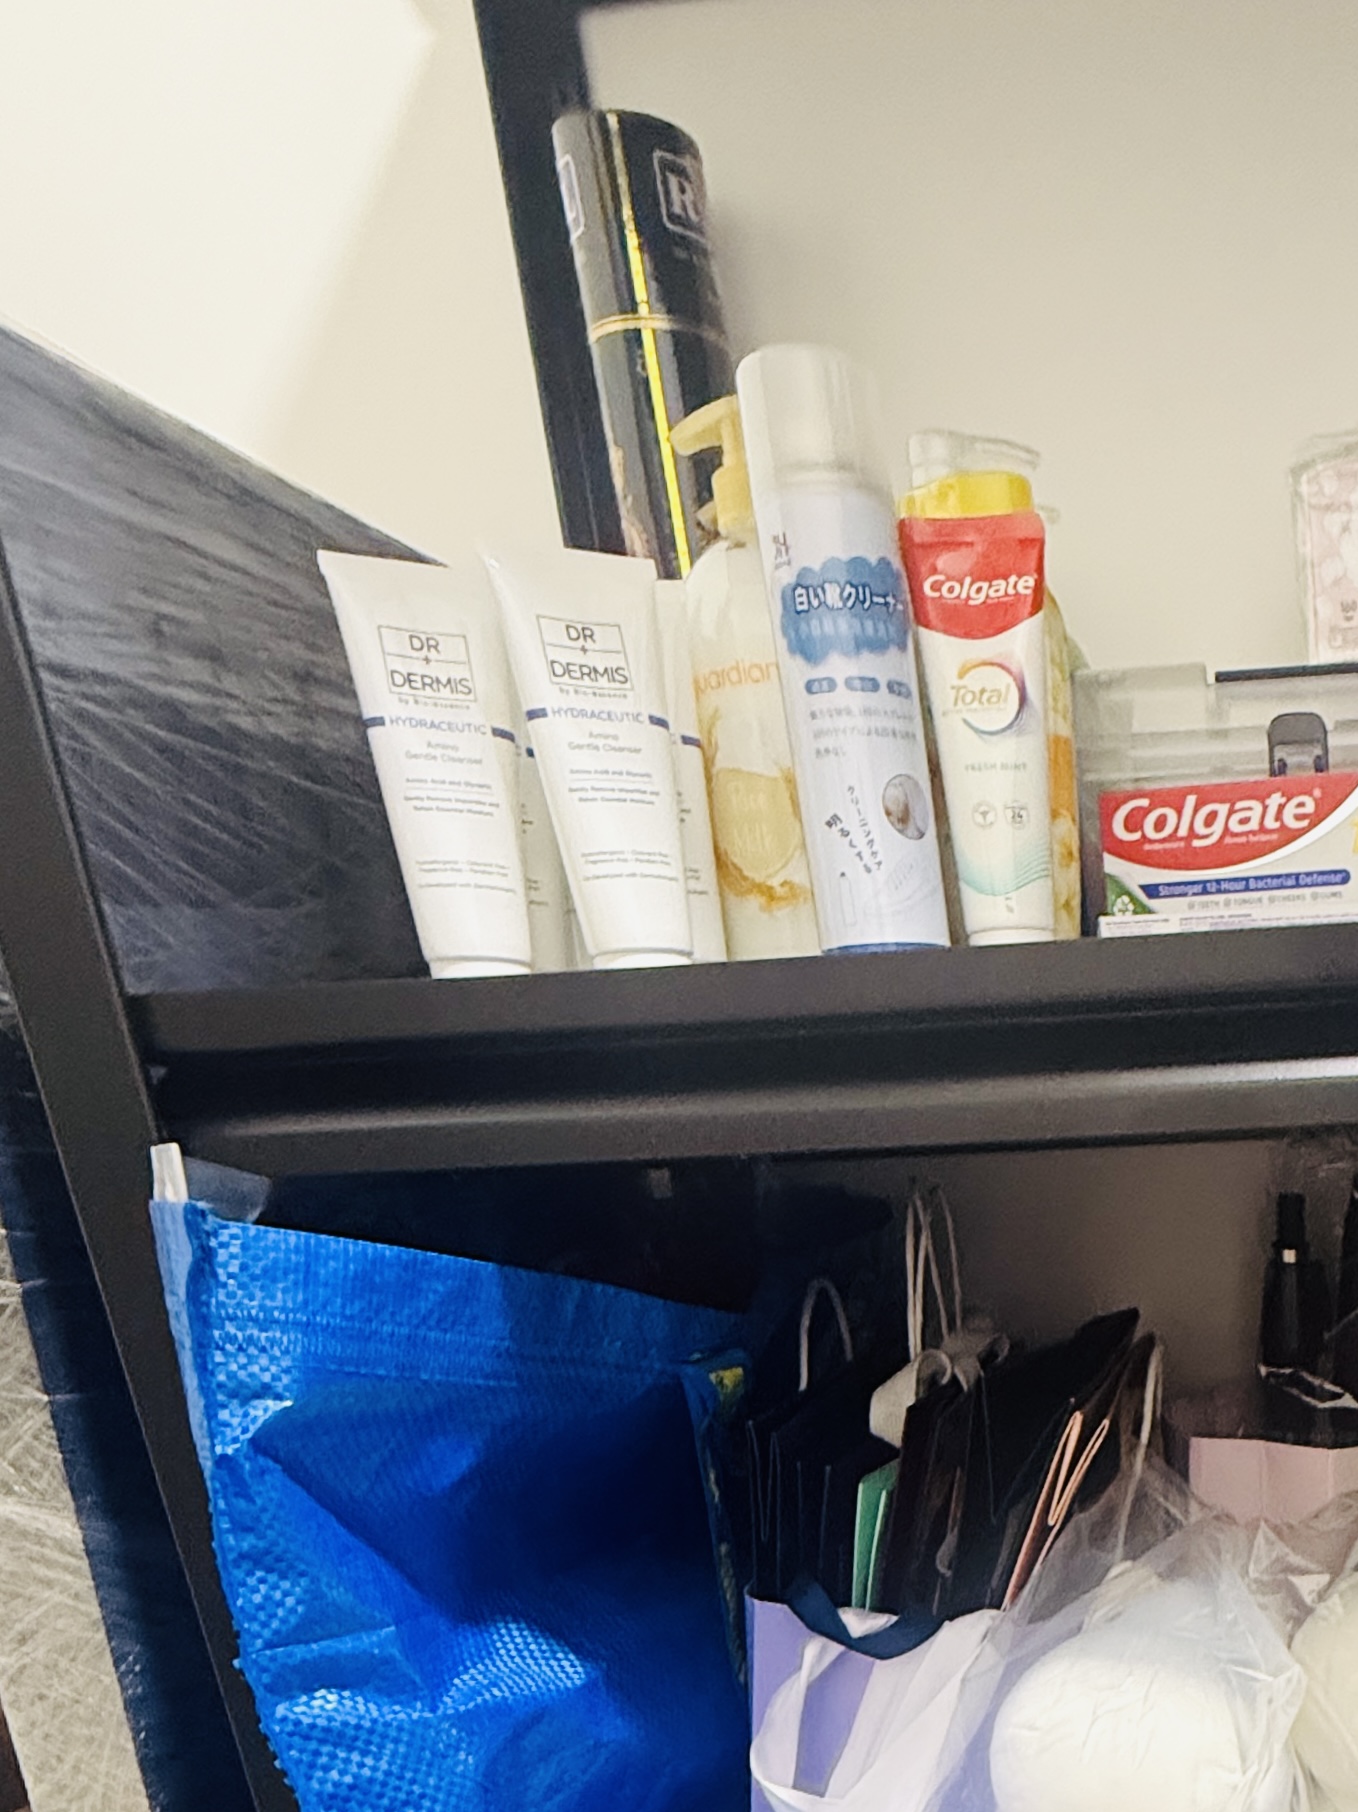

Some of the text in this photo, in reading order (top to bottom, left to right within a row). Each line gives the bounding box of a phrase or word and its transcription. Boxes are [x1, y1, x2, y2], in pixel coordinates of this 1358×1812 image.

[923, 573, 1036, 605] Colgate
[408, 634, 442, 654] DR
[565, 624, 597, 644] DR
[390, 670, 473, 696] DERMIS
[550, 660, 629, 685] DERMIS
[950, 682, 1011, 708] Total
[389, 717, 488, 735] HYDRACEUTIC
[551, 706, 645, 724] HYDRACEUTIC
[1112, 790, 1317, 848] Colgate
[1158, 882, 1204, 897] Stronger
[1249, 875, 1297, 890] Bacterial
